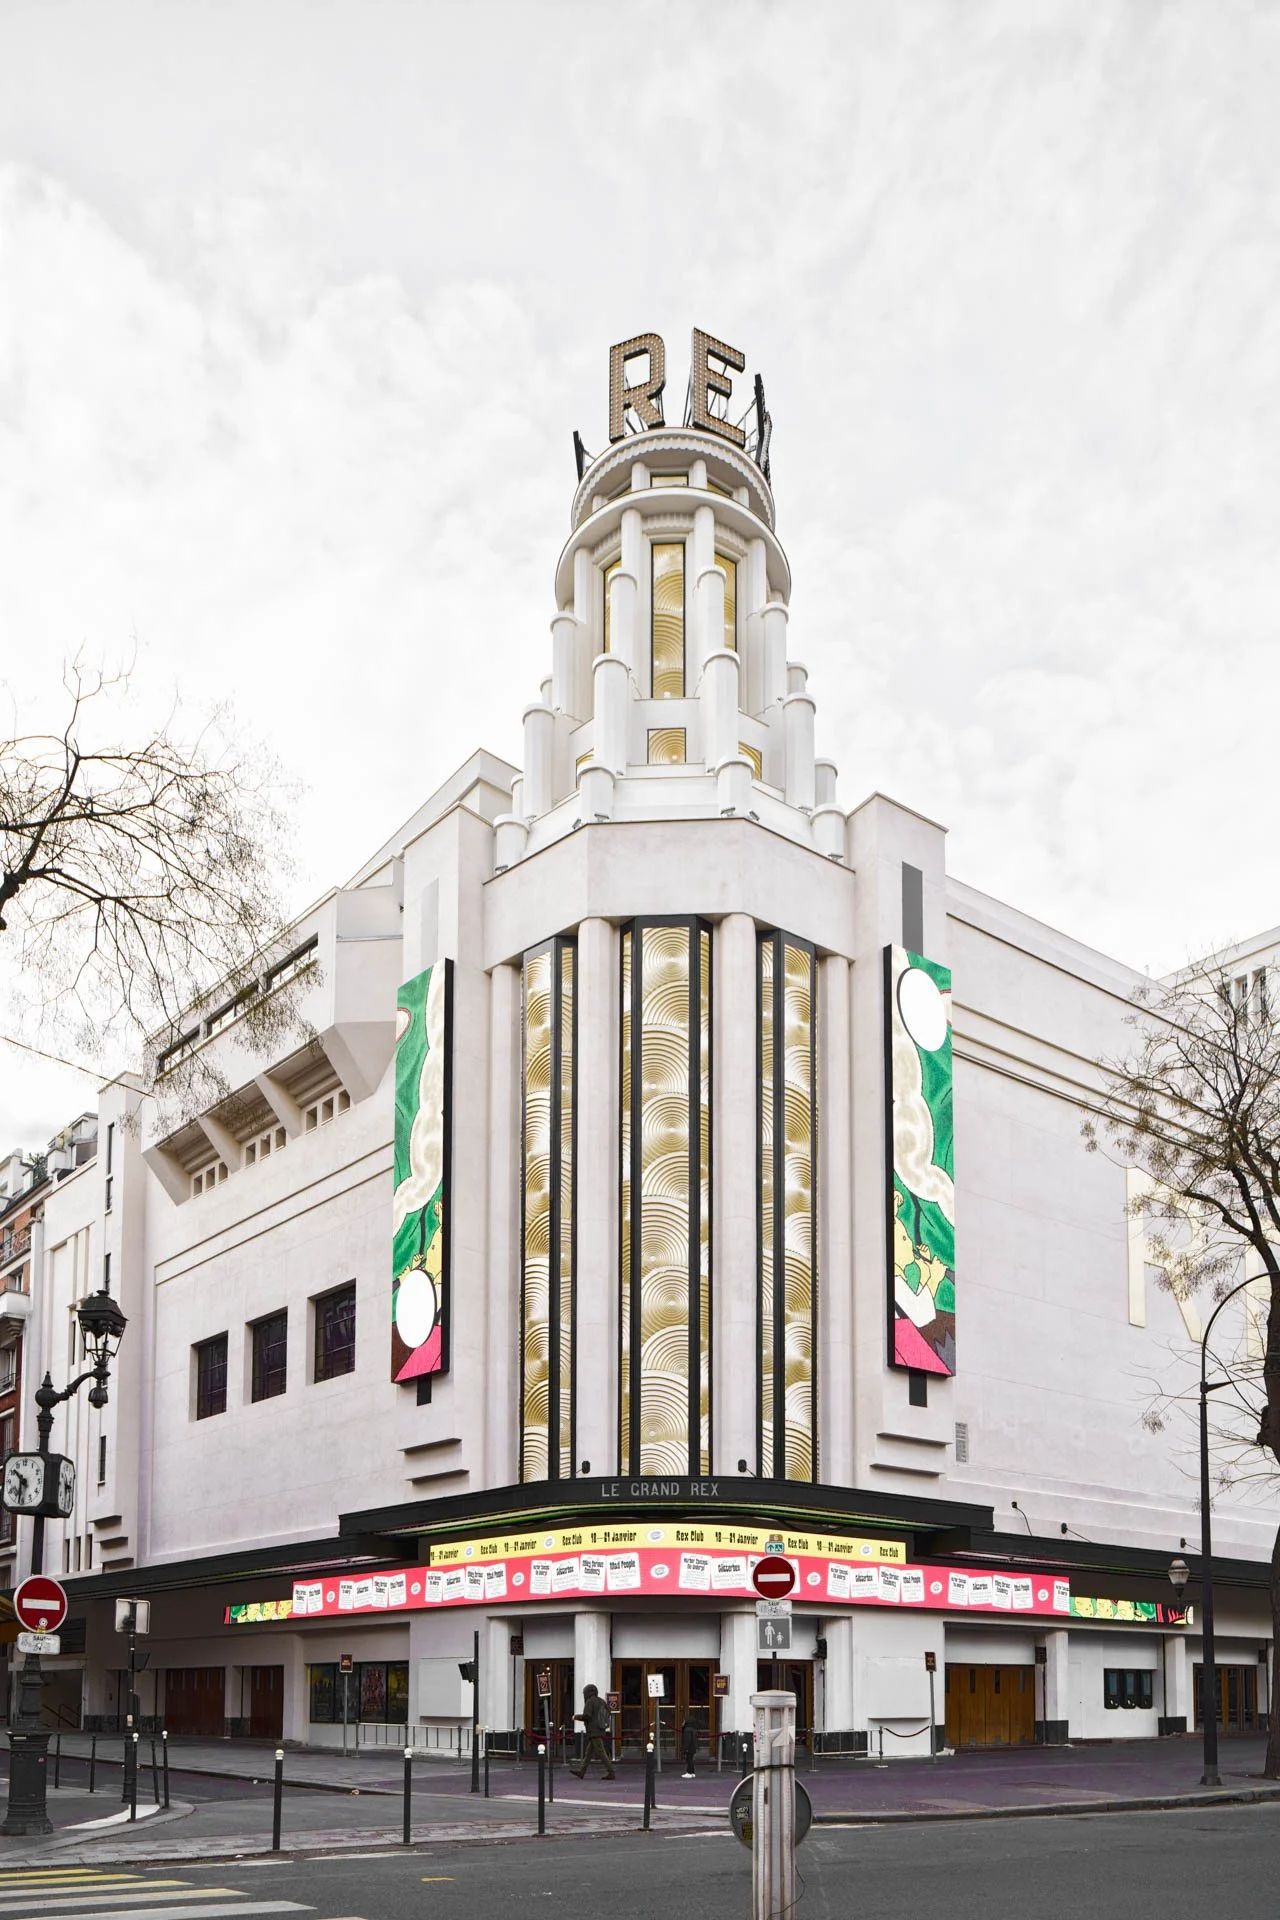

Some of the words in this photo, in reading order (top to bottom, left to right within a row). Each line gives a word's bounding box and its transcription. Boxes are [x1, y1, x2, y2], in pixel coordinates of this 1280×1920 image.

[601, 1483, 620, 1497] LE
[630, 1482, 680, 1496] GRAND
[690, 1482, 719, 1496] REX
[562, 1535, 571, 1546] Rex
[572, 1533, 582, 1545] Club
[611, 1529, 637, 1542] Janvier
[676, 1530, 688, 1541] Rex
[690, 1530, 704, 1542] Club
[737, 1533, 759, 1545] Janvier
[787, 1538, 798, 1548] Rex
[798, 1539, 809, 1550] Club
